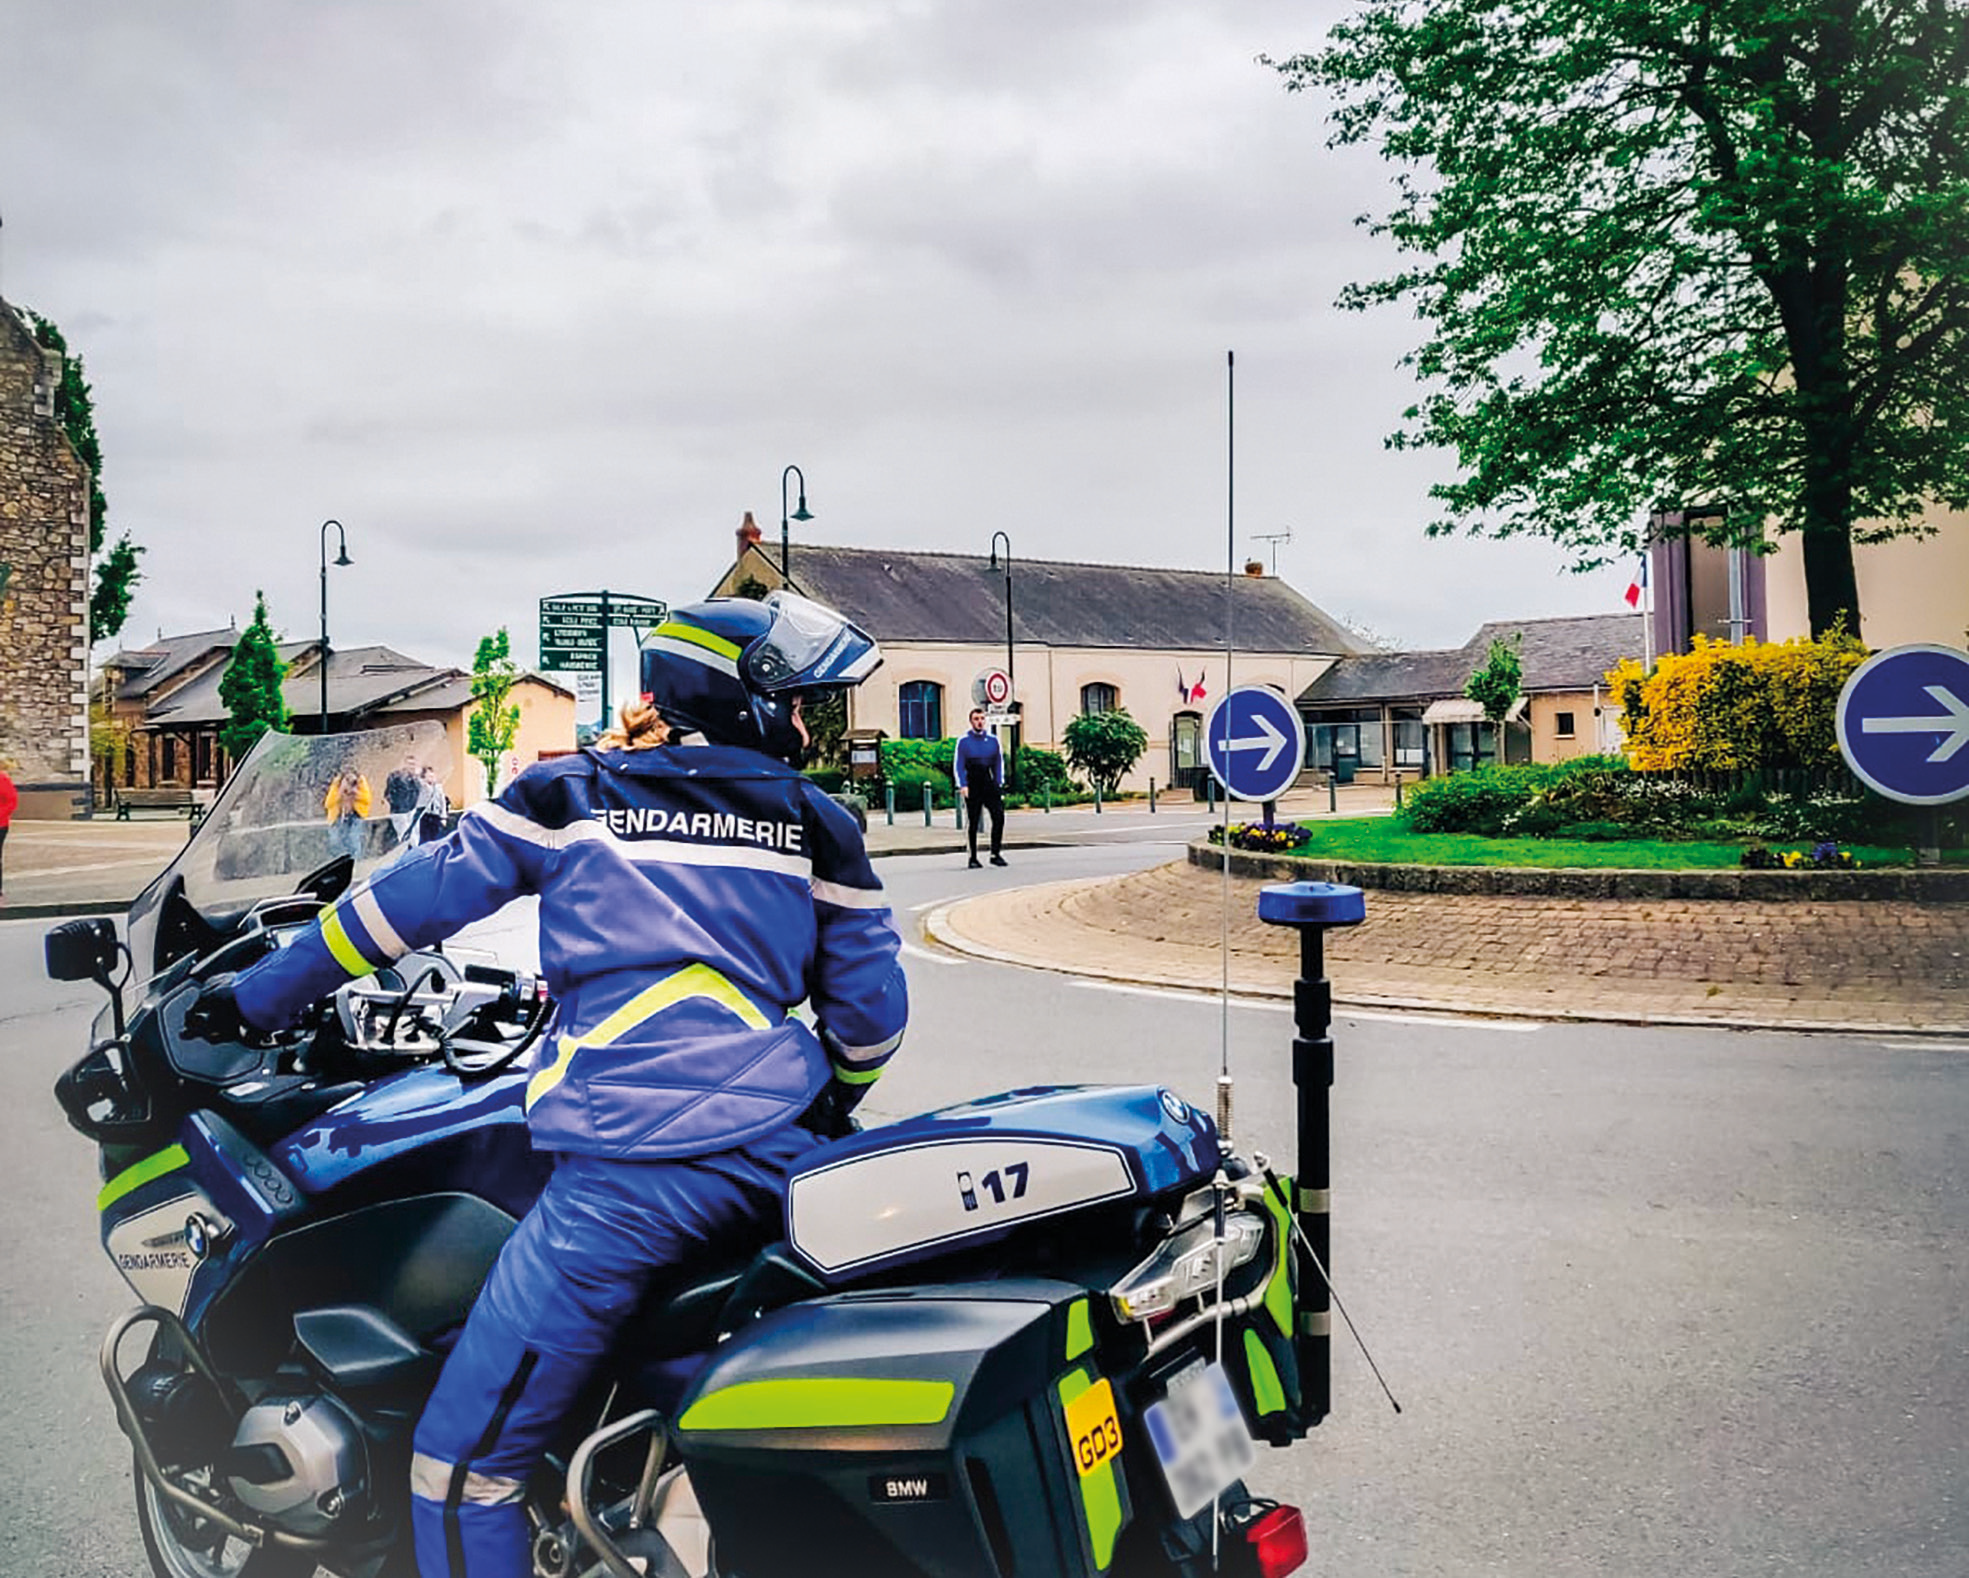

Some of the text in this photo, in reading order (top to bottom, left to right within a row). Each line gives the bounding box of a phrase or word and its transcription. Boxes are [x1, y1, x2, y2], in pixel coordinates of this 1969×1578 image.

[981, 1161, 1029, 1204] 17
[119, 1252, 190, 1269] GENDARMERIE
[1078, 1415, 1119, 1470] GD3
[886, 1478, 927, 1497] BMW
